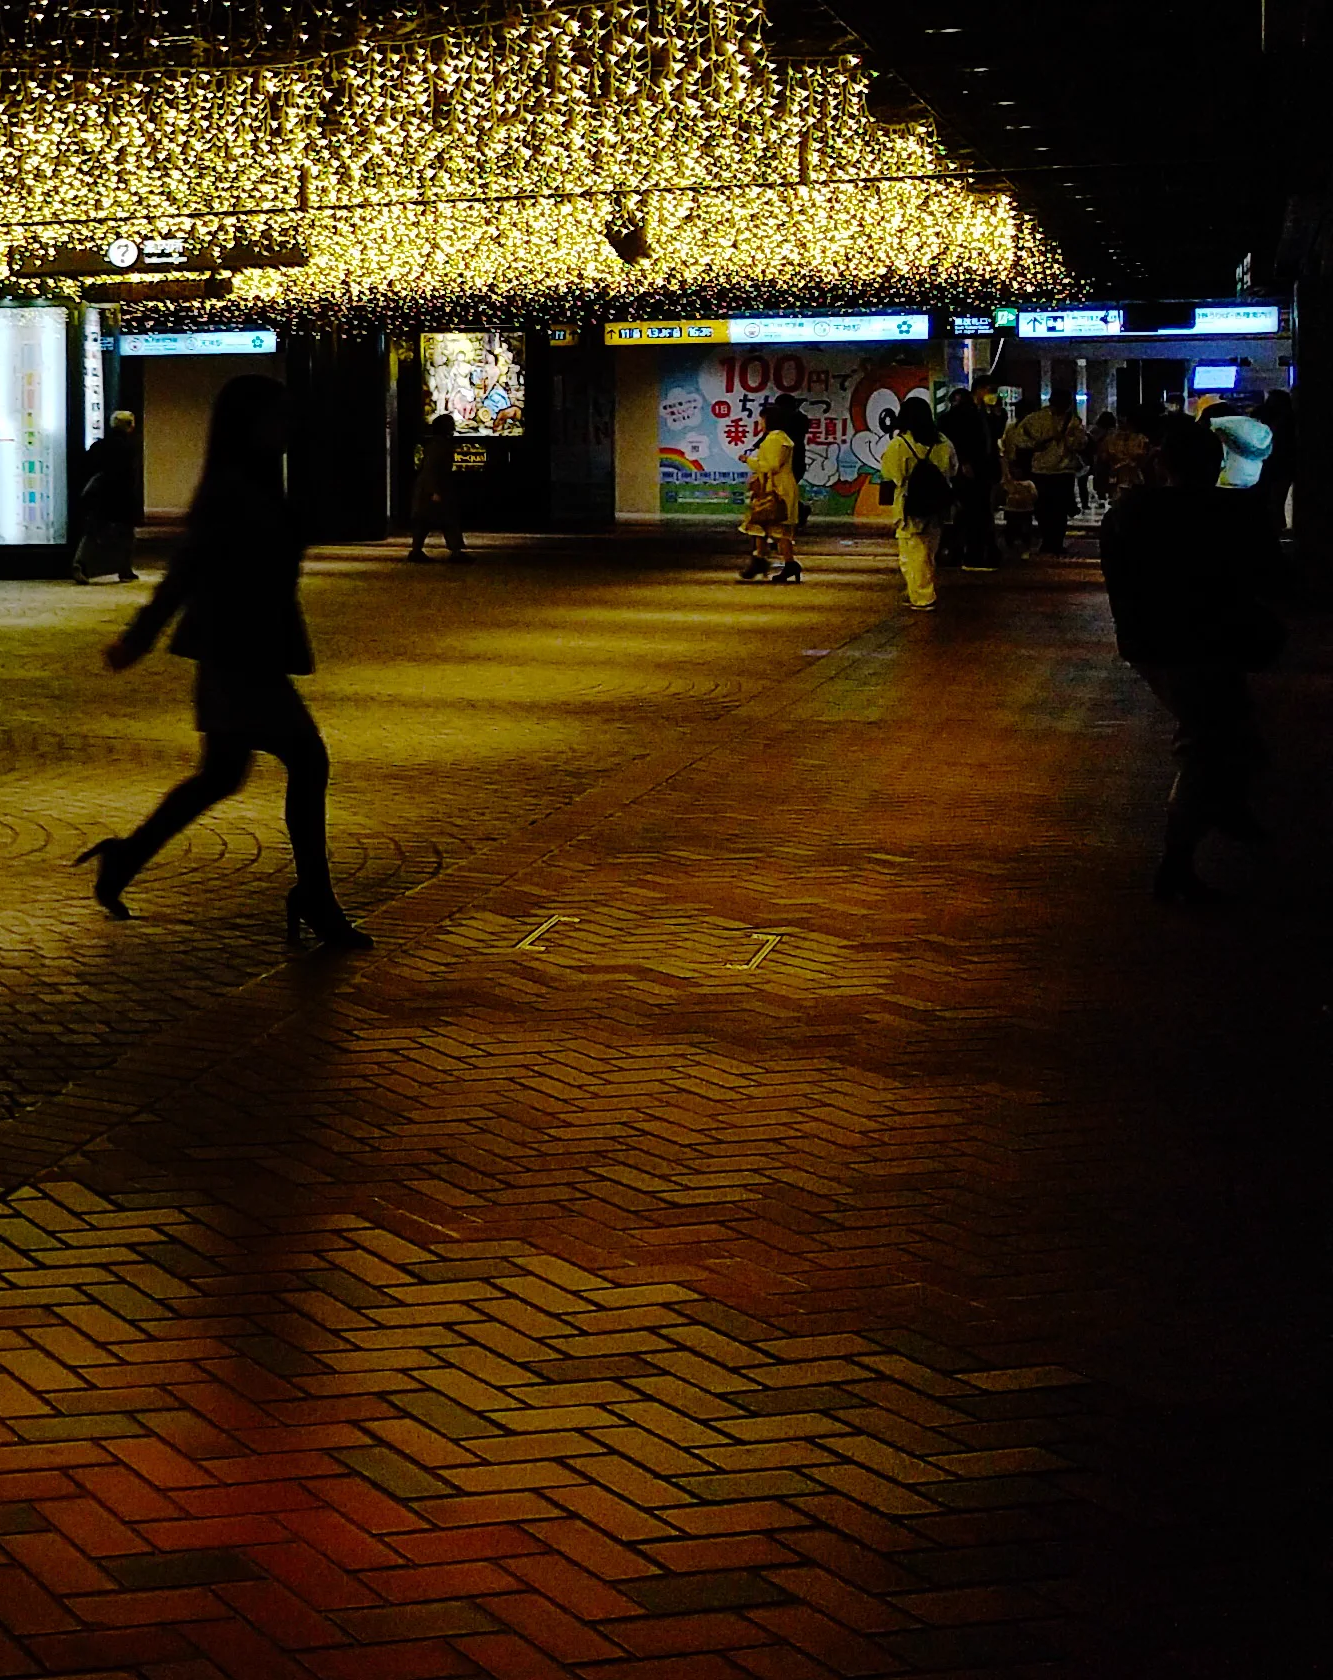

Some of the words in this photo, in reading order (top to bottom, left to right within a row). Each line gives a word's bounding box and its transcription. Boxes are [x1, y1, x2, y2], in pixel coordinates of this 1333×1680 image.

[720, 354, 858, 394] 100円で
[739, 394, 831, 418] ちつ
[724, 418, 848, 446] 乗り題!
